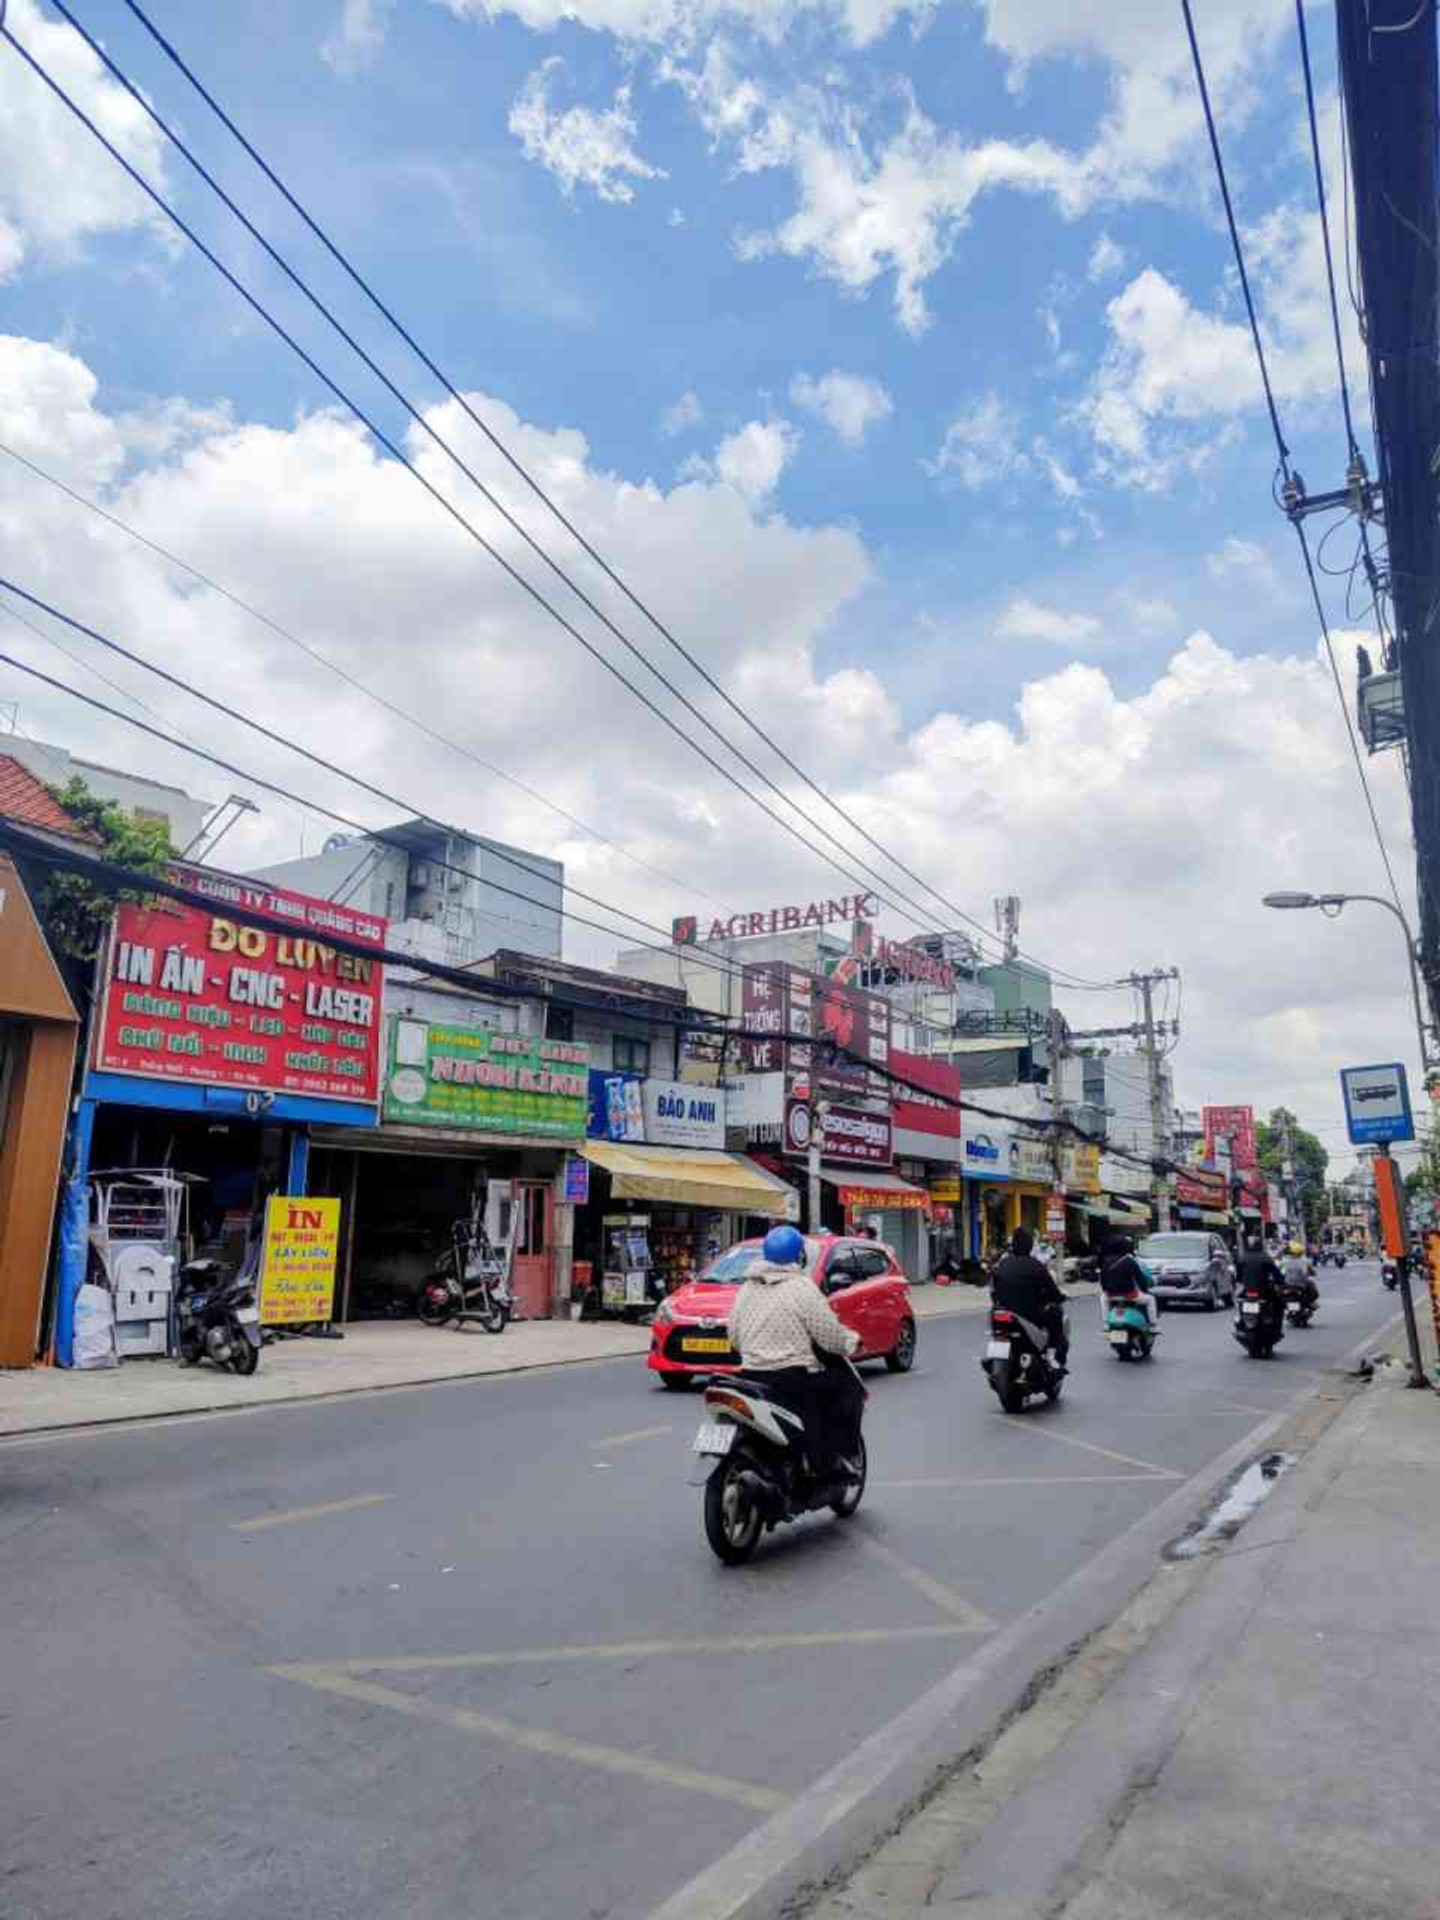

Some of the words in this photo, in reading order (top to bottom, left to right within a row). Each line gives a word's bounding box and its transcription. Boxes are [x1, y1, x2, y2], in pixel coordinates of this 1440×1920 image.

[708, 891, 876, 940] AGRIBANK
[117, 941, 154, 985] IN
[160, 942, 205, 996] ẤN
[228, 966, 284, 1011] CNC
[304, 983, 374, 1027] LASER
[688, 1098, 716, 1123] ANH
